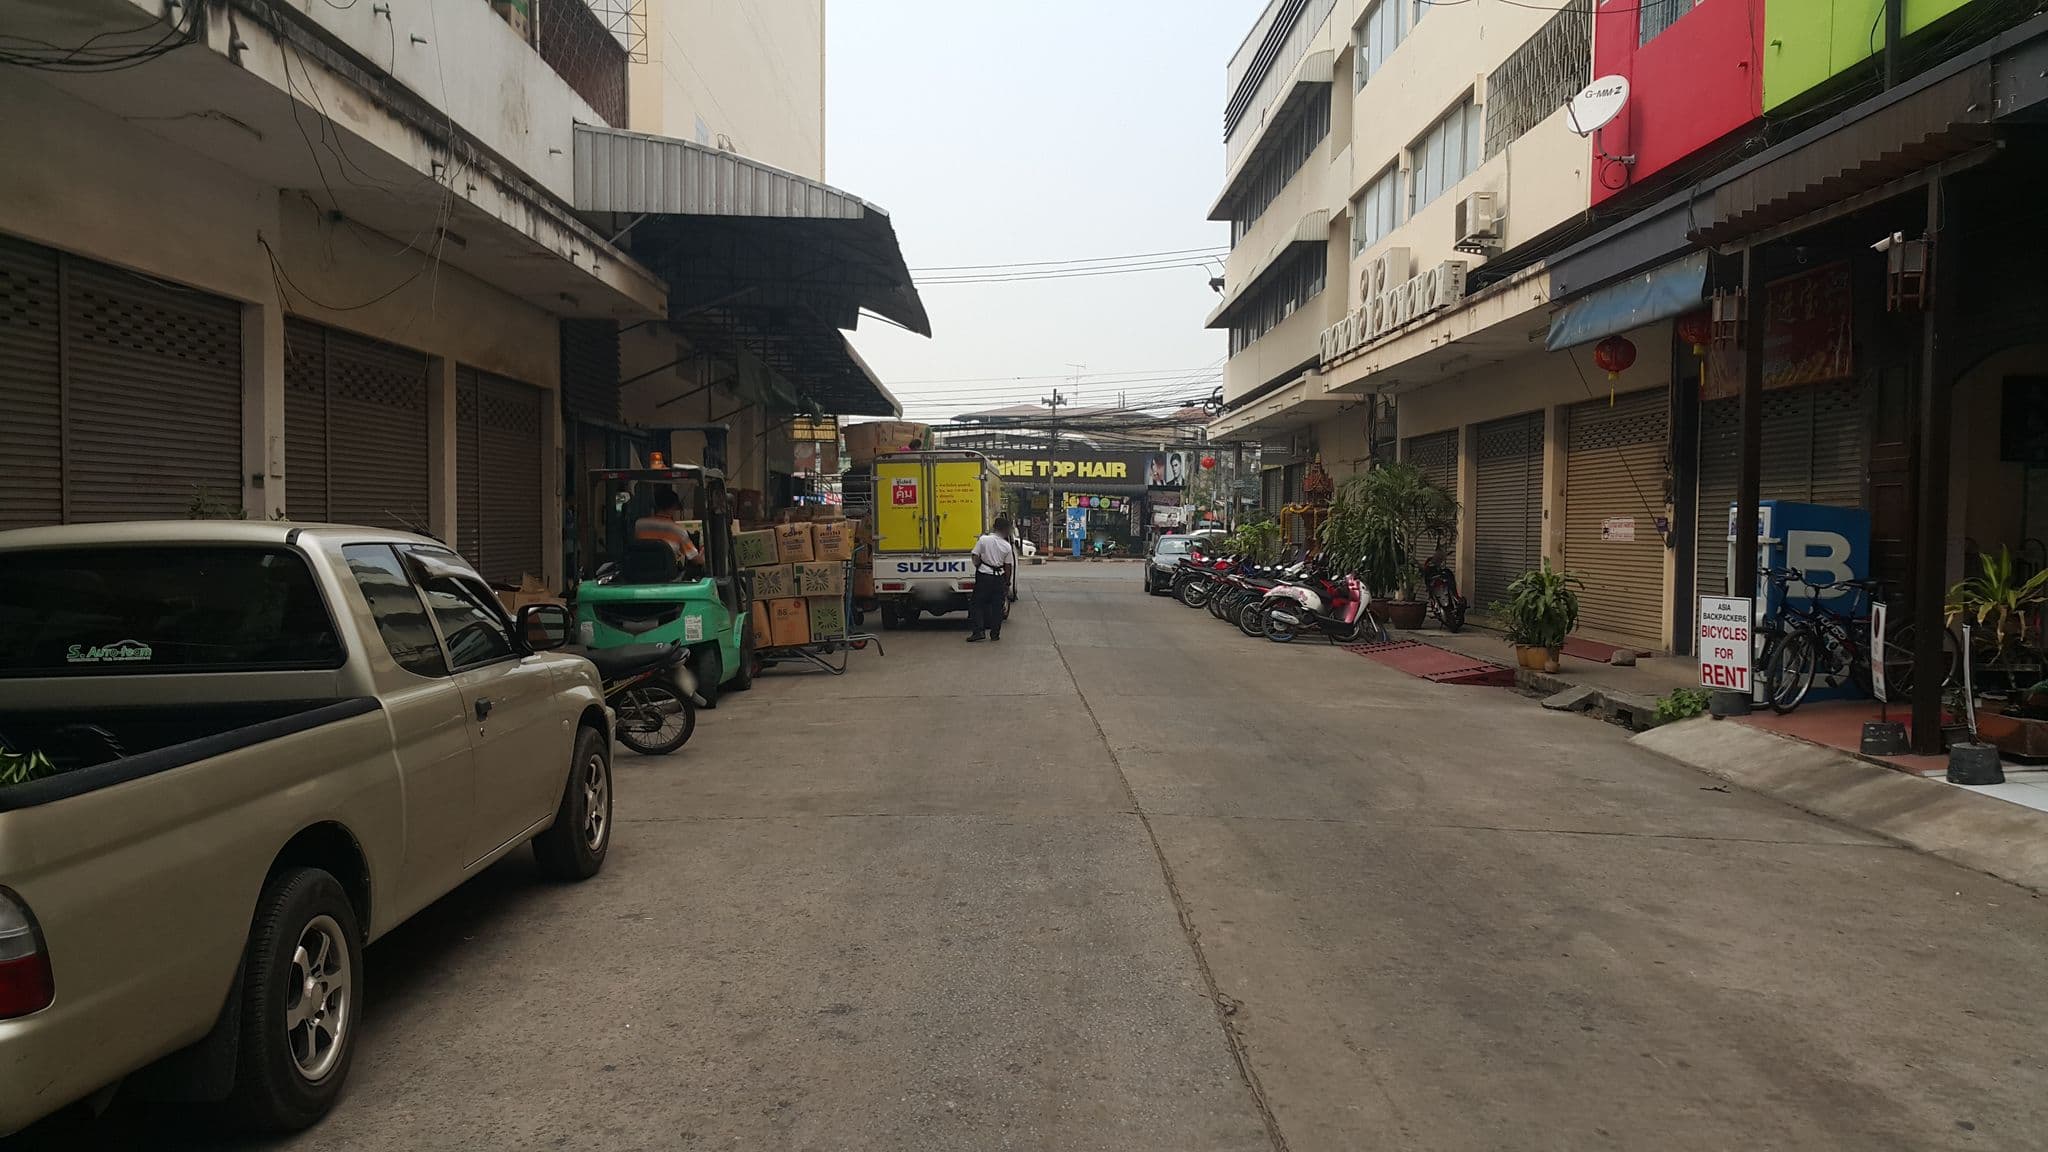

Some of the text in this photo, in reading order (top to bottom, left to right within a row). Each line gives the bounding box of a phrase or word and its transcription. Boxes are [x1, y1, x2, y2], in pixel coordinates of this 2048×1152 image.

[1037, 461, 1076, 477] TOP
[1078, 461, 1127, 478] HAIR
[897, 562, 966, 572] SUZUKI
[1786, 530, 1854, 598] B
[1703, 613, 1747, 622] BACKPACKERS
[1702, 625, 1747, 641] BICYCLES
[1715, 648, 1733, 659] FOR
[1702, 664, 1747, 689] RENT
